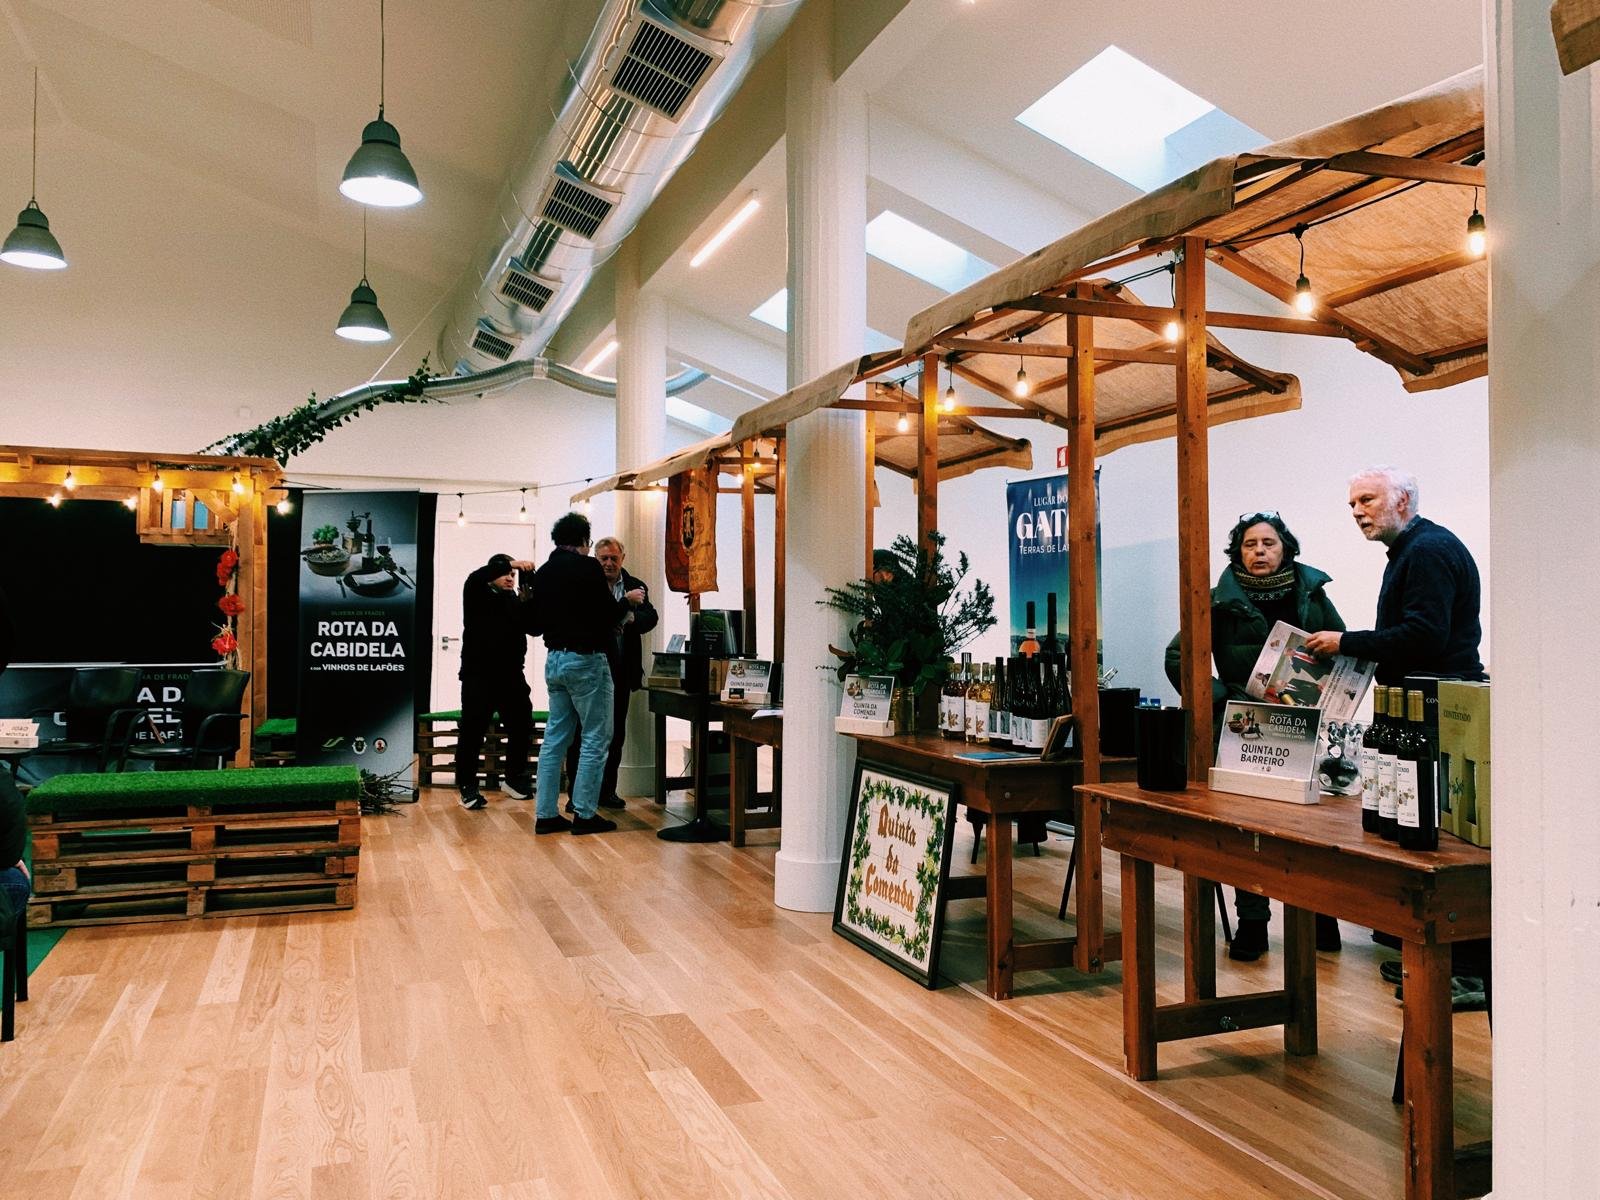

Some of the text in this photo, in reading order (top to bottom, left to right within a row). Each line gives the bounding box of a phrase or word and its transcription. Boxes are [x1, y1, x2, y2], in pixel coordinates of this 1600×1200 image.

[1034, 494, 1068, 506] LUGAR DO
[1016, 508, 1069, 540] GAT
[1019, 544, 1069, 555] TERRAS DE LA
[318, 621, 399, 637] ROTA DA
[310, 642, 406, 658] CABIDELA
[322, 663, 356, 671] VINHOS
[356, 663, 369, 671] DE
[370, 662, 405, 672] LAFÕES
[153, 673, 165, 681] DE
[167, 673, 191, 681] FRAD
[162, 686, 185, 703] D
[1269, 715, 1307, 727] ROTA DA
[1268, 724, 1306, 735] CABIDELA
[1241, 743, 1290, 758] QUINTA DO
[1240, 754, 1285, 767] BARREIRO
[878, 803, 916, 848] Quinta
[885, 844, 899, 876] da
[865, 862, 916, 913] Comenda
